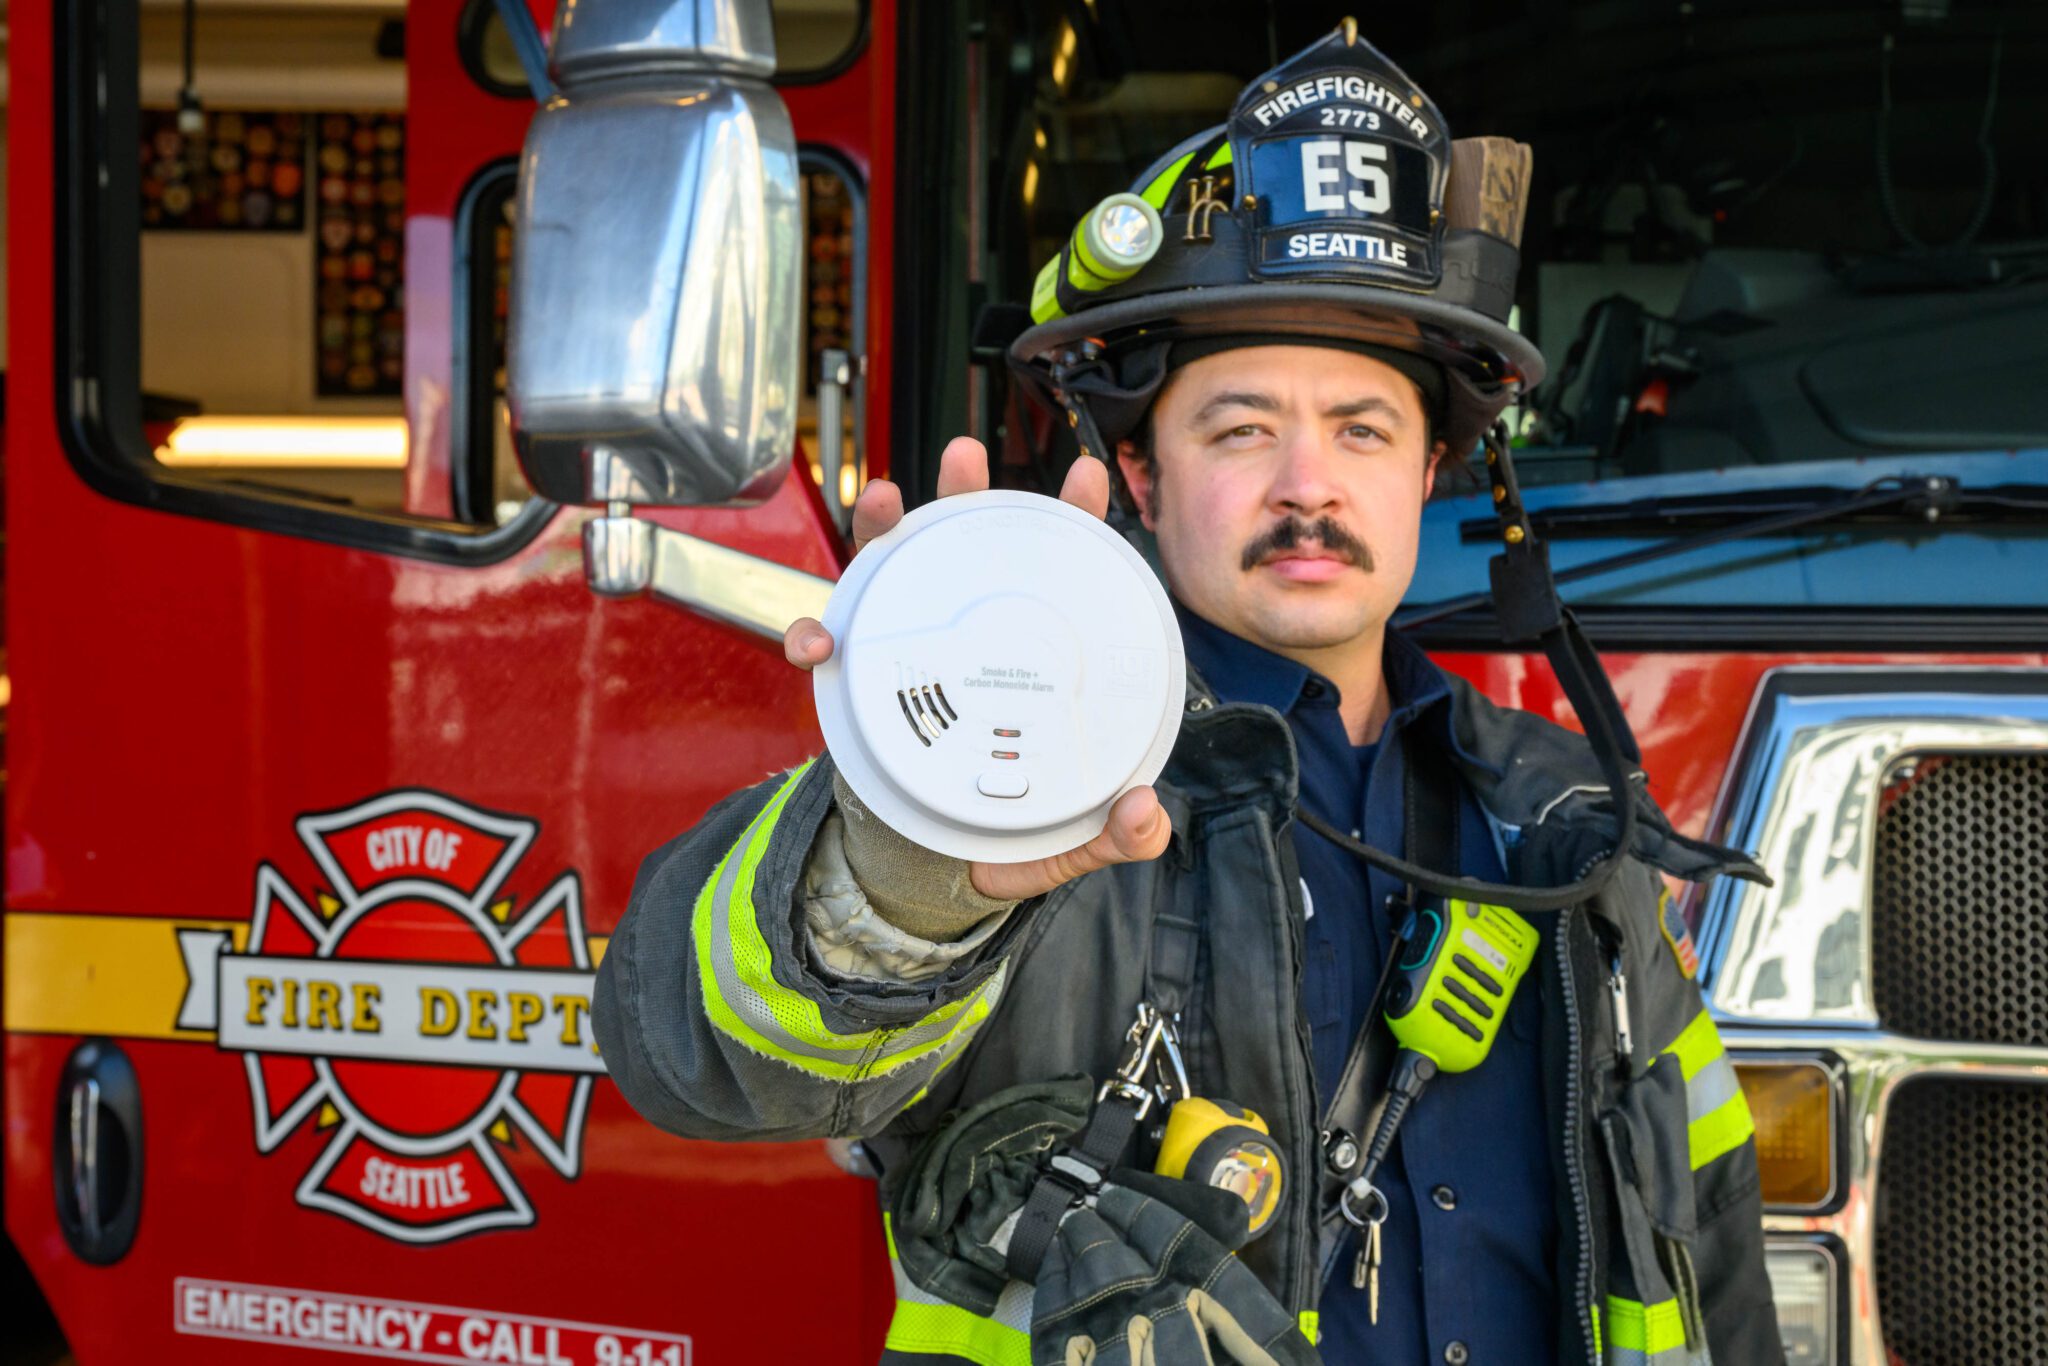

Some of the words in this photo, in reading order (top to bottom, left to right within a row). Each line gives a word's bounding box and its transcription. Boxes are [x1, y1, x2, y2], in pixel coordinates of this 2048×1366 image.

[1253, 76, 1429, 140] FIREFIGHTER
[1320, 108, 1381, 130] 2773
[1301, 140, 1392, 214] E5
[1288, 233, 1408, 267] SEATTLE
[963, 677, 991, 688] Carbon
[981, 666, 1007, 678] Smoke
[366, 826, 422, 871] CITY
[425, 827, 462, 871] OF
[245, 977, 383, 1033] FIRE
[360, 1157, 470, 1208] SEATTLE
[458, 1316, 574, 1366] CALL
